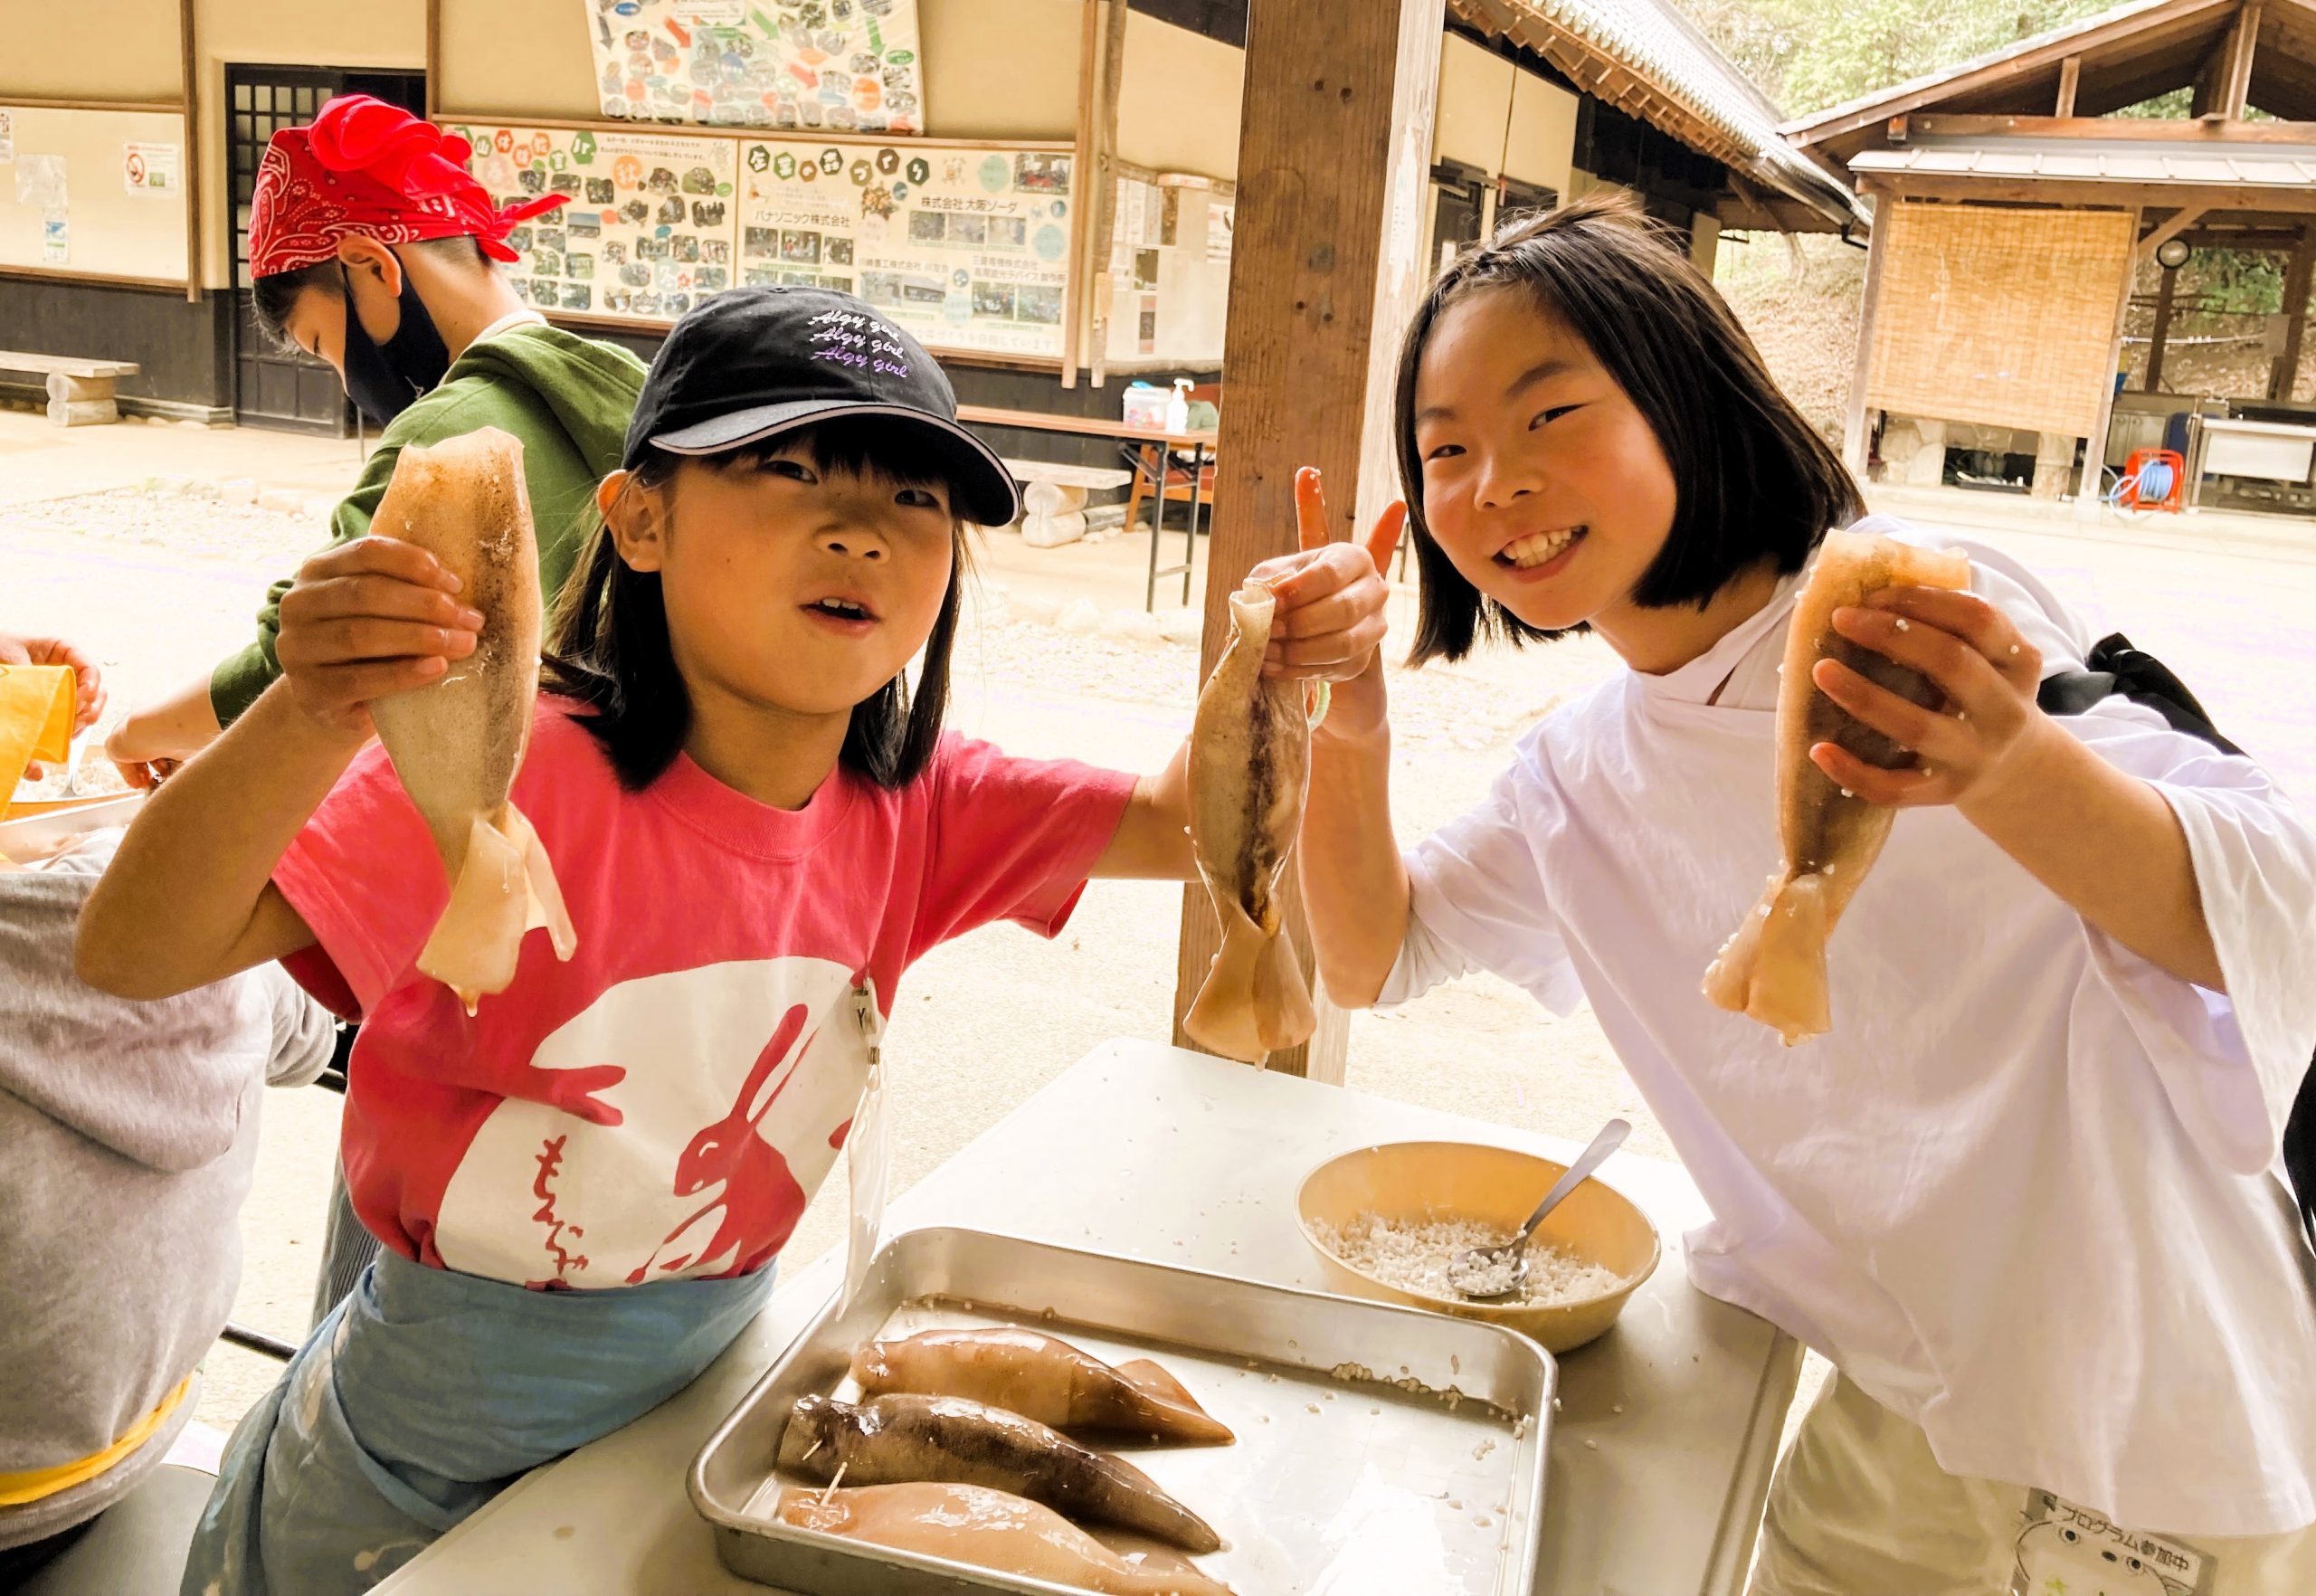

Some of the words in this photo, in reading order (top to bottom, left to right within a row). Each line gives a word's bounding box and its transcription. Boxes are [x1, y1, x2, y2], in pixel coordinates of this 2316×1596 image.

[755, 210, 850, 228] パナソニック株式会社
[808, 309, 866, 329] Algy
[809, 326, 867, 348] Algy
[871, 339, 905, 359] girl
[810, 345, 868, 367] Algy
[873, 358, 908, 378] girl
